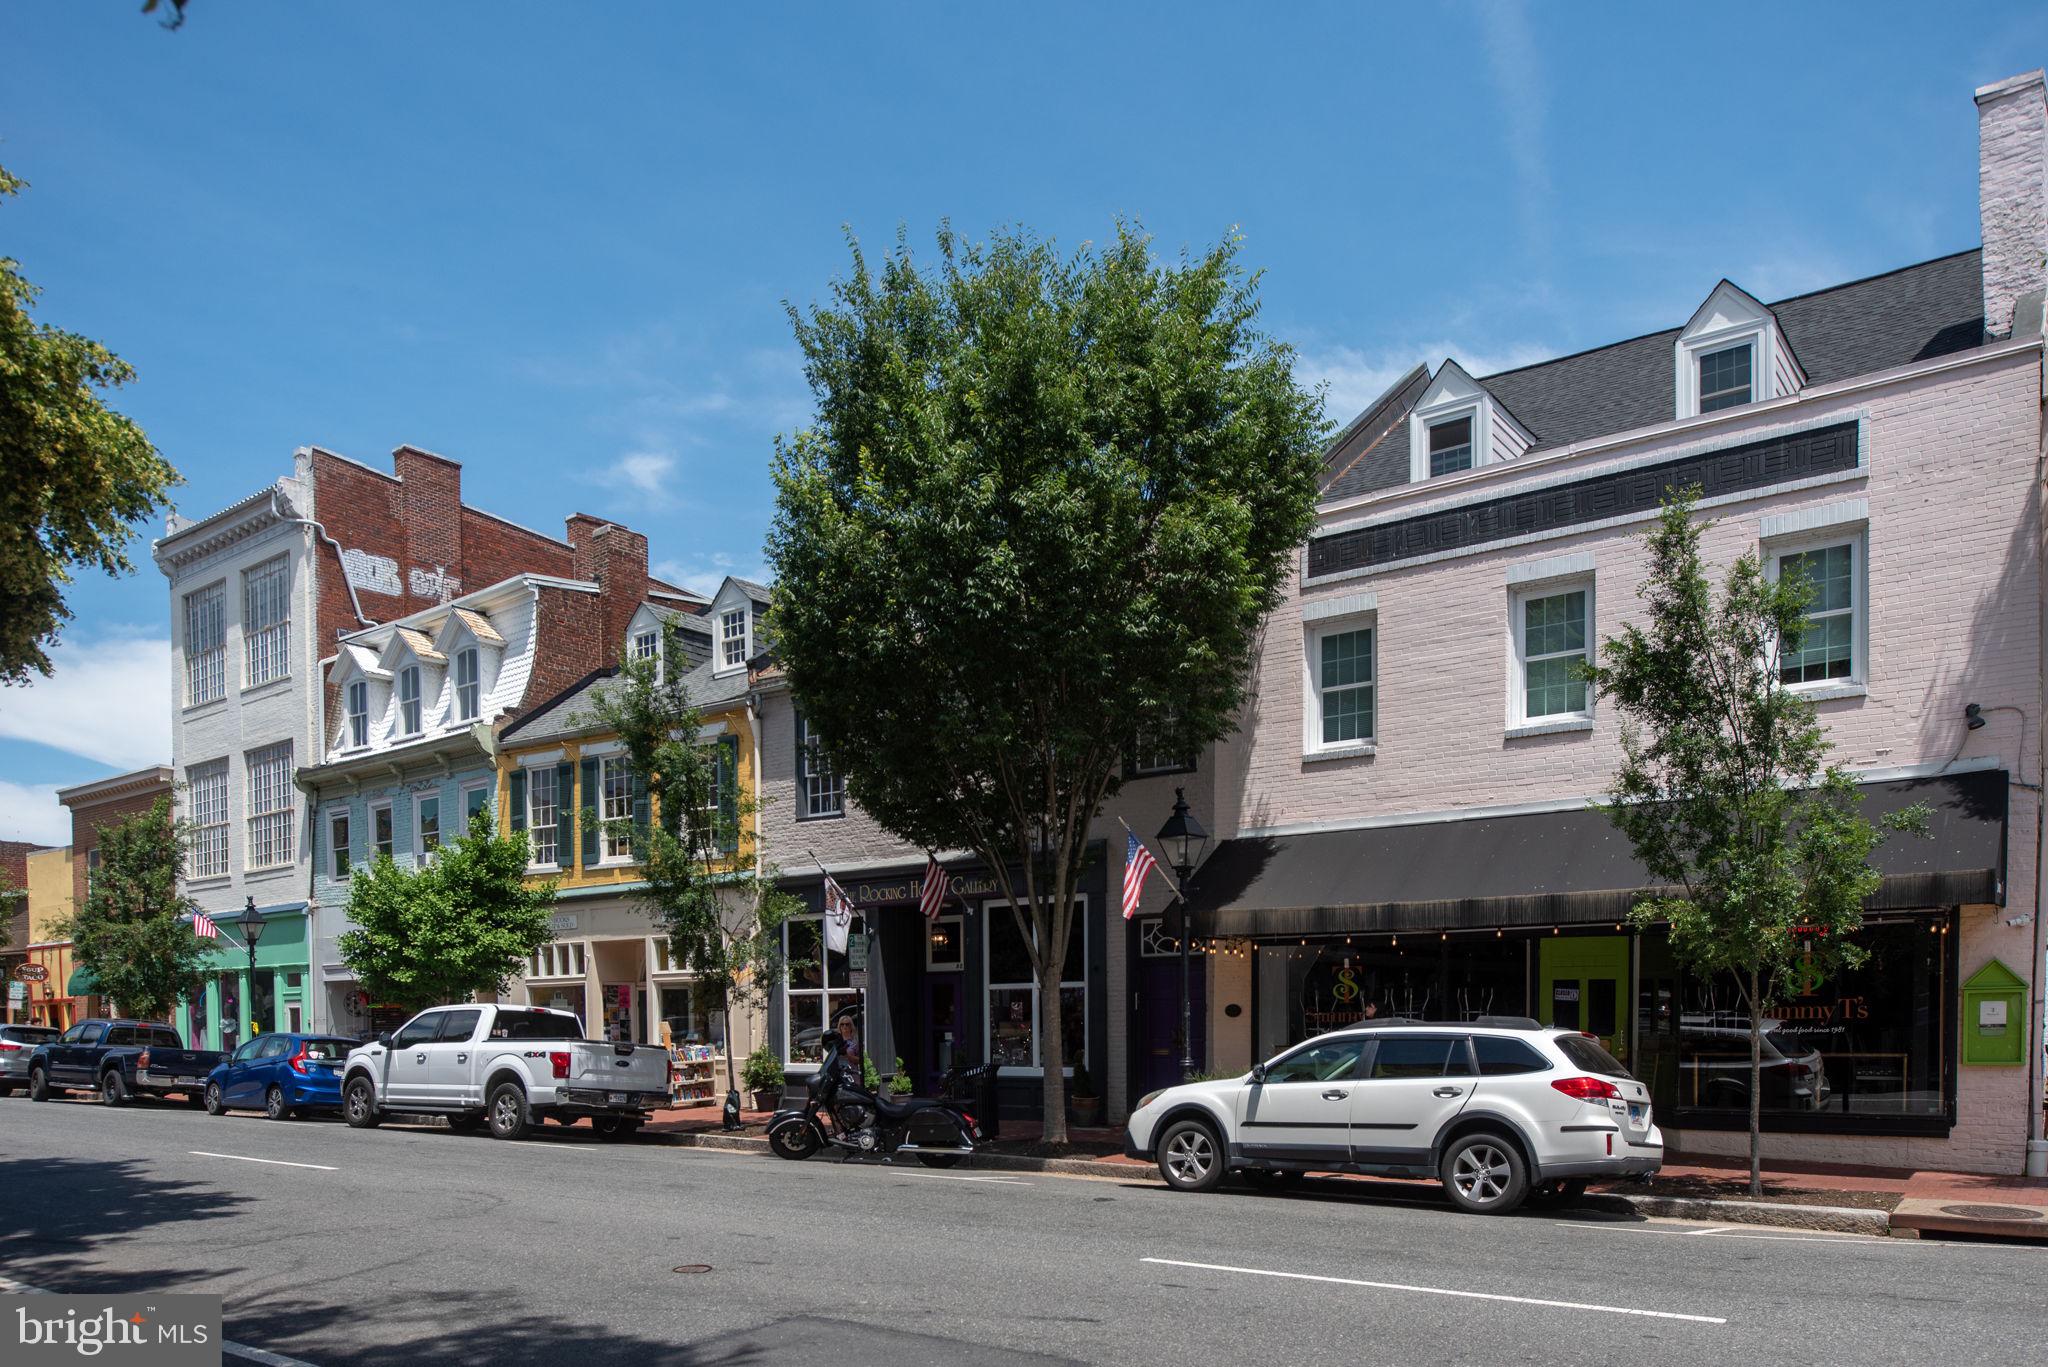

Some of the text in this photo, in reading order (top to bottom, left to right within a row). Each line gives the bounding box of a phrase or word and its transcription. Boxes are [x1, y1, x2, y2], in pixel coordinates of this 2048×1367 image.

[859, 884, 907, 903] ROCKING
[951, 876, 998, 896] GALLERY
[1763, 996, 1869, 1026] ammy T's
[1782, 1026, 1798, 1034] good
[1798, 1026, 1813, 1034] food
